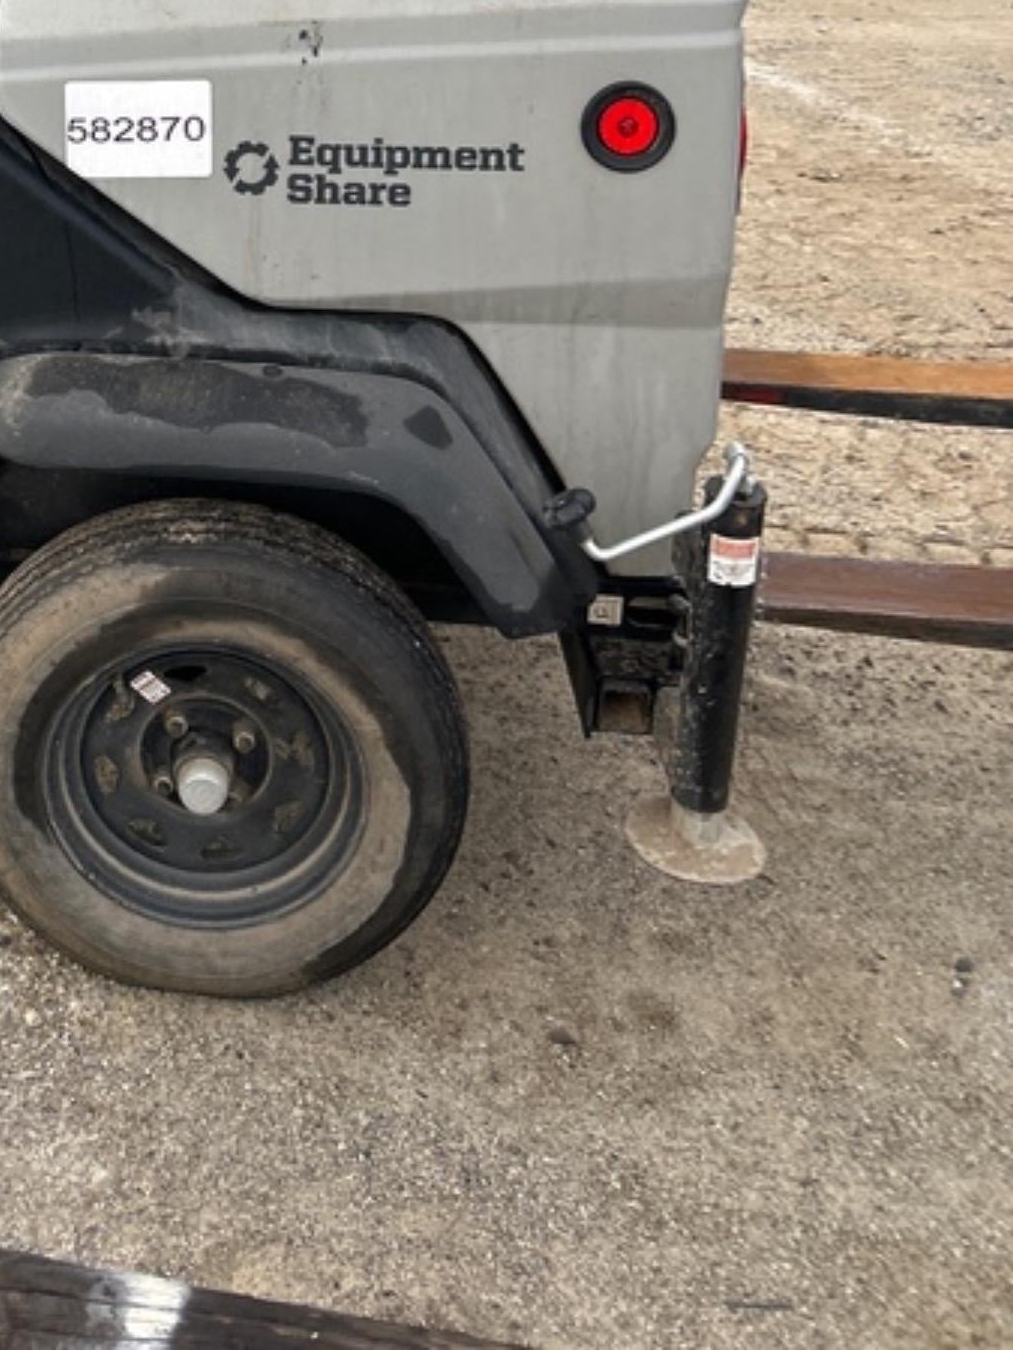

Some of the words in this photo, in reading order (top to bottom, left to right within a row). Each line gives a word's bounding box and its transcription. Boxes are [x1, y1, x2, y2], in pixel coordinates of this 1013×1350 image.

[67, 115, 206, 144] 582870
[288, 134, 526, 176] Equipment
[287, 173, 412, 207] Share
